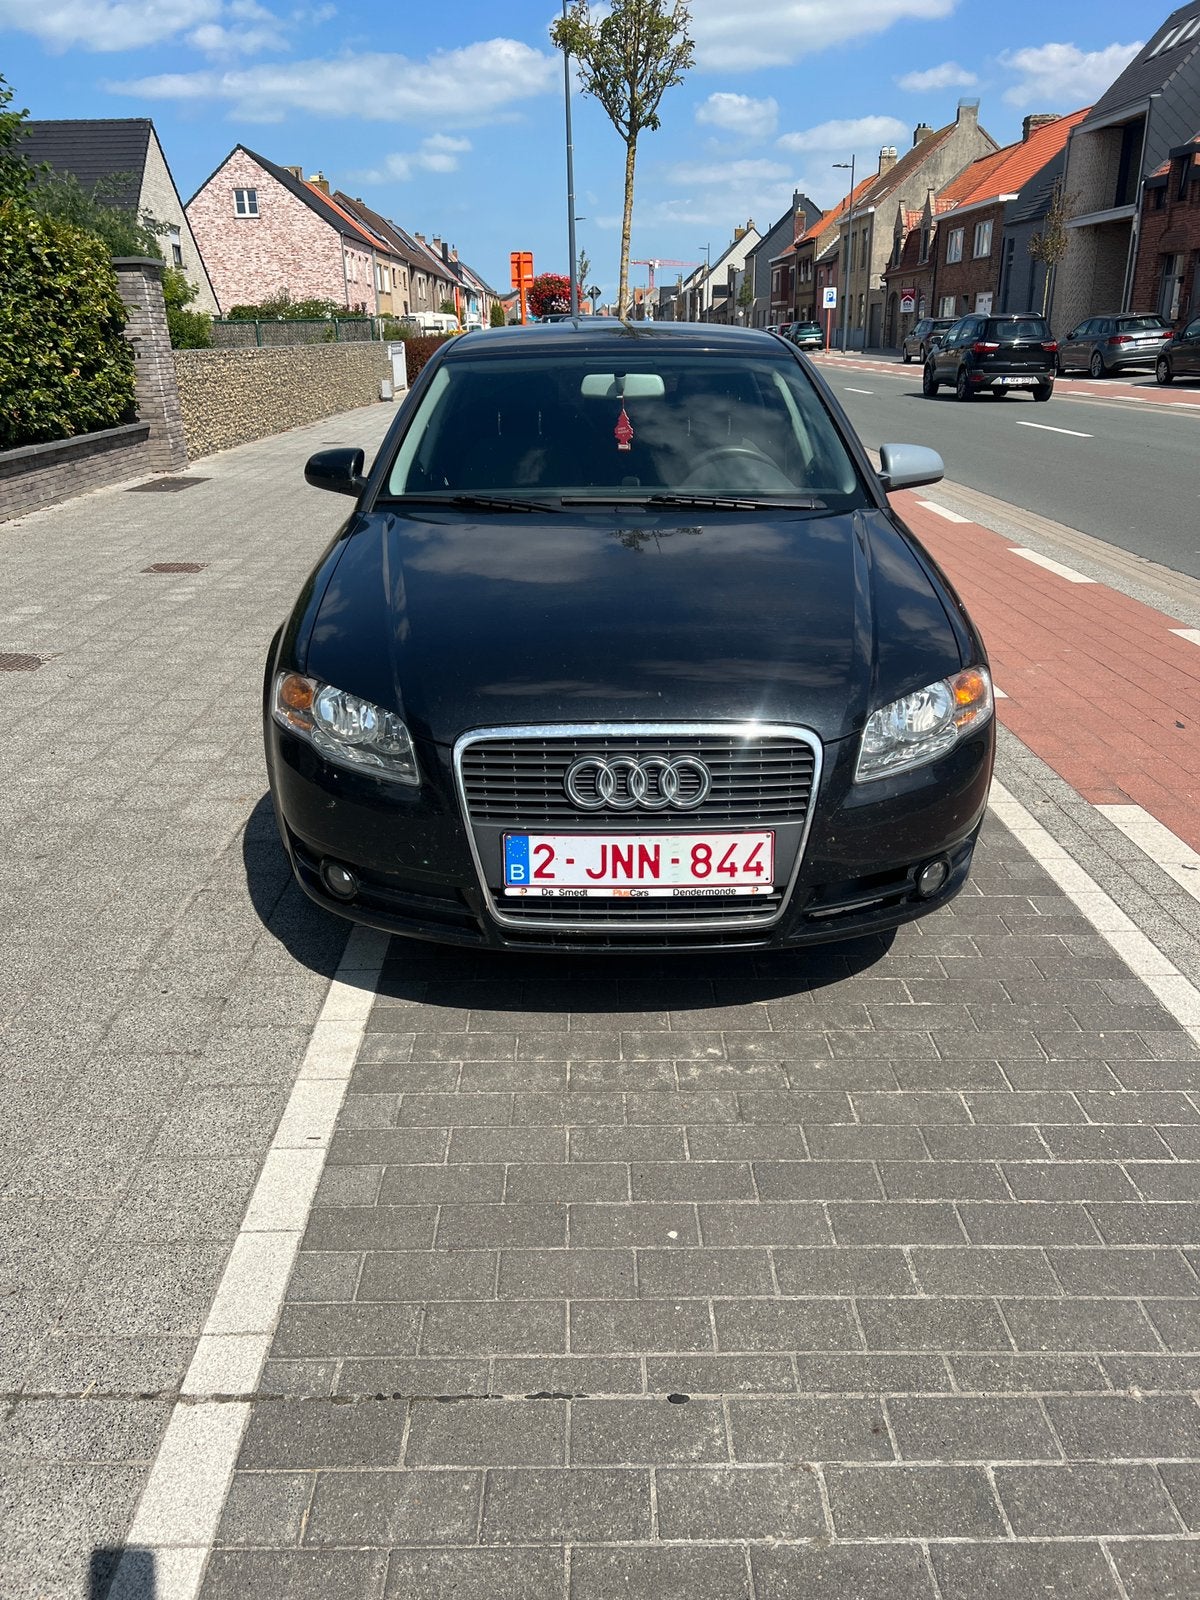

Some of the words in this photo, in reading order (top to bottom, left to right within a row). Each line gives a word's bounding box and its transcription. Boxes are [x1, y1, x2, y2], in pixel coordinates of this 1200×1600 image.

[510, 864, 525, 880] B
[542, 888, 555, 896] De
[559, 888, 588, 897] Smedt
[672, 887, 737, 897] Dendermonde
